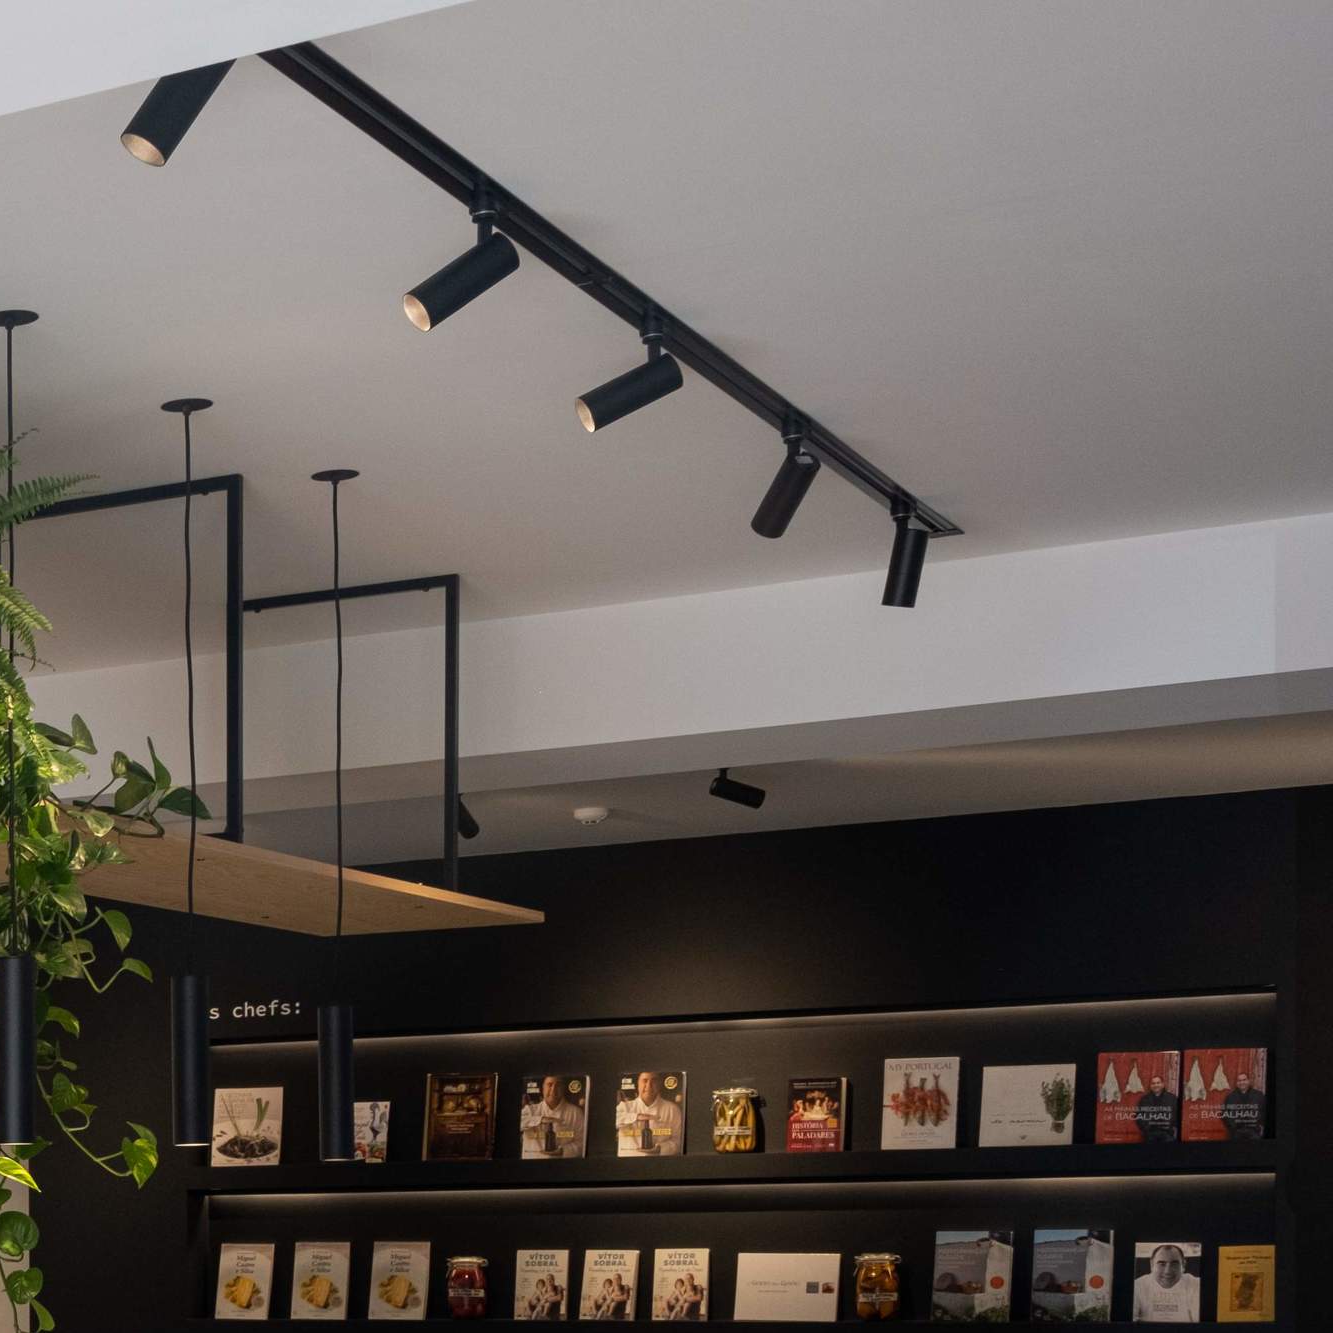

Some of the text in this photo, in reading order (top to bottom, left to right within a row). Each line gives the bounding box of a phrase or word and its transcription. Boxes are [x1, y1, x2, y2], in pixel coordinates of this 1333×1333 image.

[232, 999, 301, 1019] chefs:
[905, 1062, 953, 1072] PORTUGAL
[1115, 1113, 1172, 1121] BACALHAU
[1201, 1111, 1259, 1119] BACALHAU
[792, 1130, 835, 1139] PALADARES
[663, 1259, 699, 1267] SOBRAL
